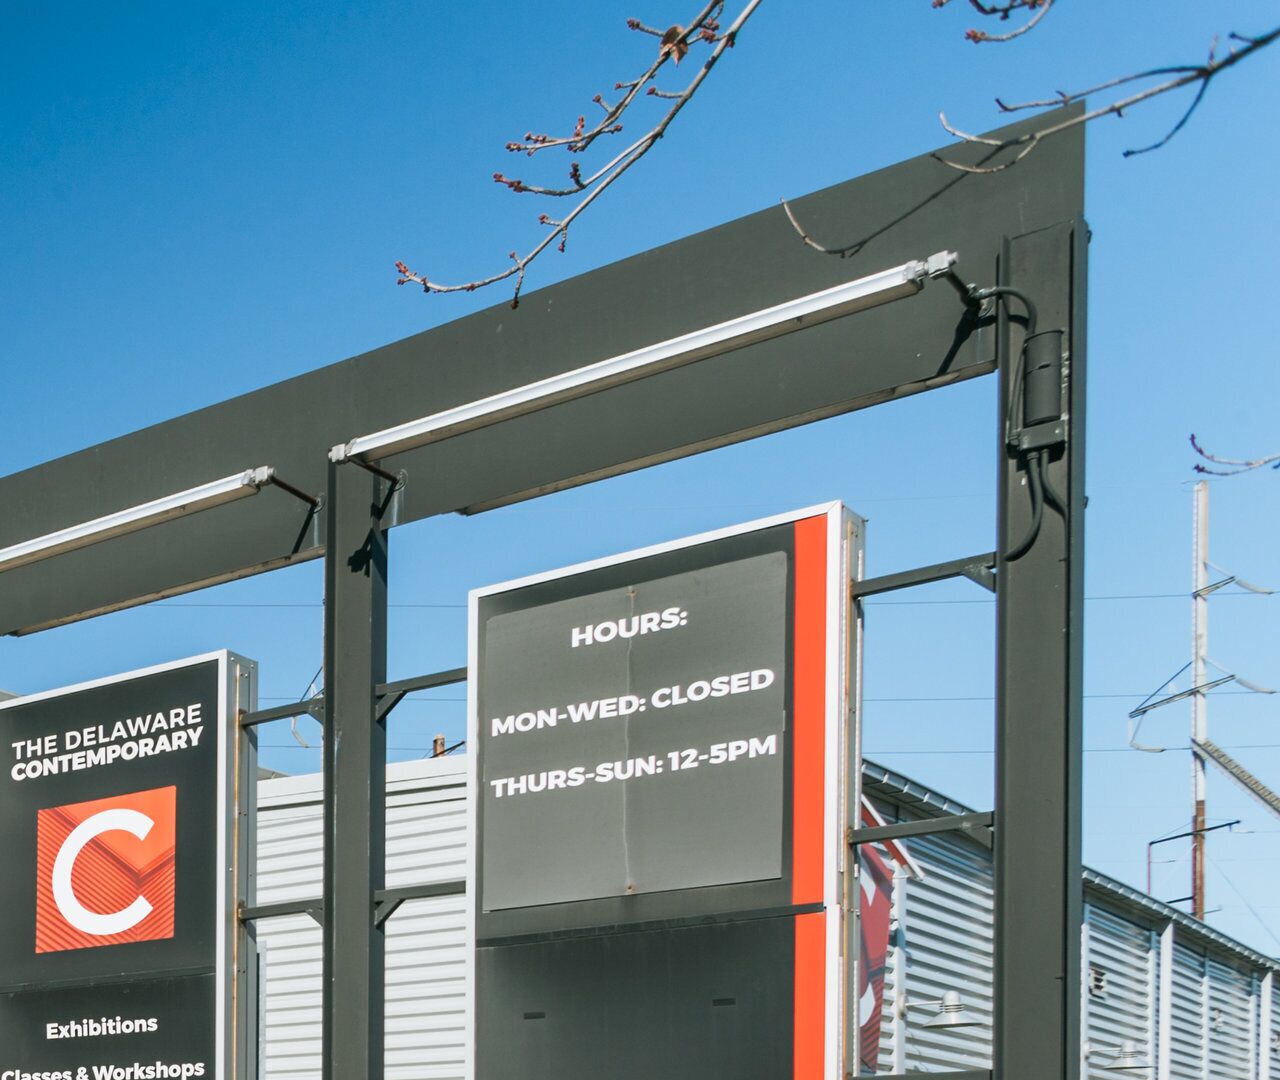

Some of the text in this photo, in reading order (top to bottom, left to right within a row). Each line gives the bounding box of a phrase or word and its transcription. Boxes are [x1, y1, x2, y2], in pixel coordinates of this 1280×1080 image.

[571, 606, 689, 648] HOURS:
[491, 668, 775, 737] MON-WED: CLOSED
[11, 703, 202, 760] THE DELAWARE
[11, 725, 204, 781] CONTEMPORARY
[490, 734, 777, 798] THURS-SUN: 12-5PM
[51, 808, 155, 936] C
[46, 1016, 158, 1039] Exhibitions
[92, 1061, 205, 1080] Workshops
